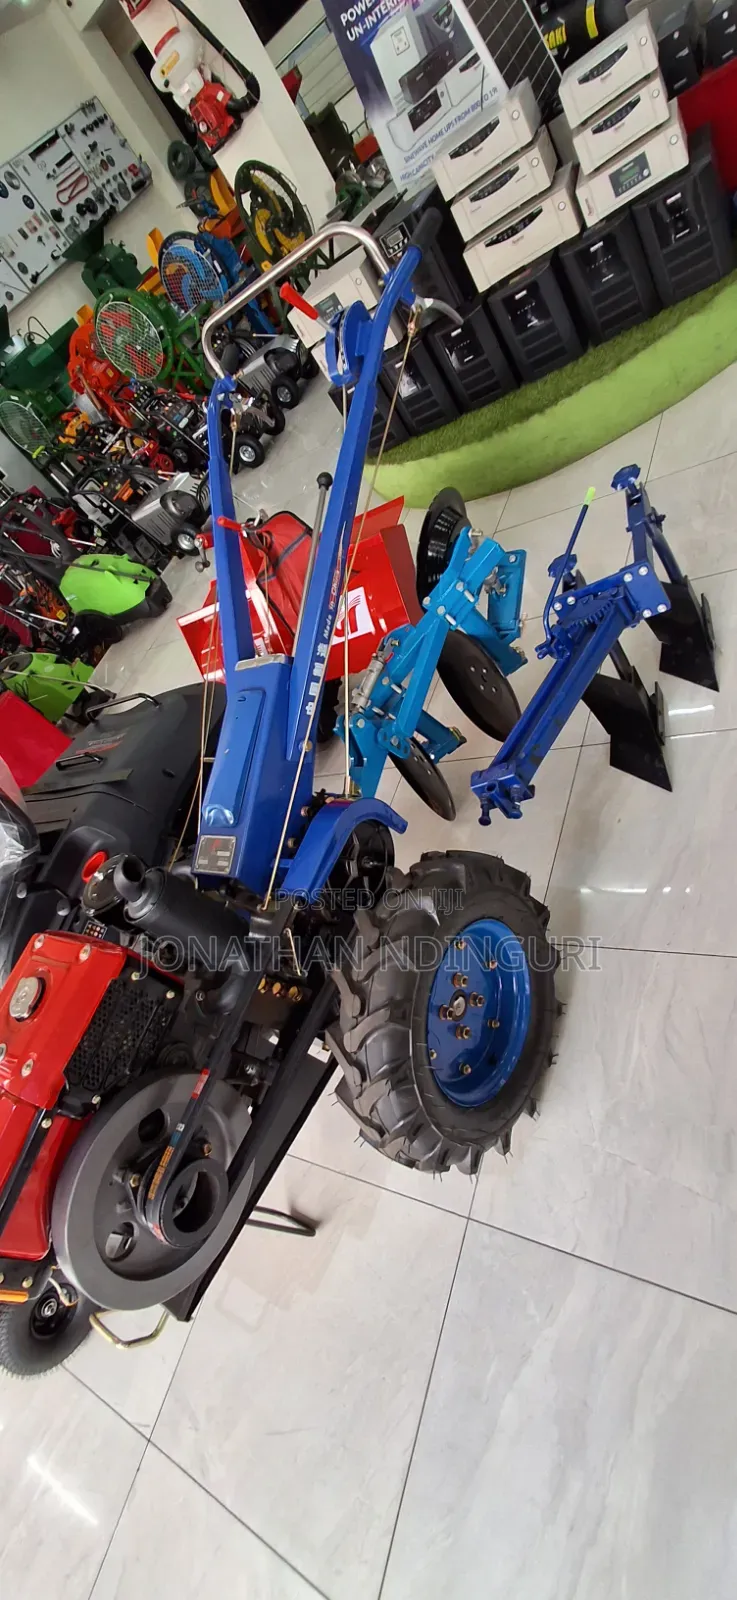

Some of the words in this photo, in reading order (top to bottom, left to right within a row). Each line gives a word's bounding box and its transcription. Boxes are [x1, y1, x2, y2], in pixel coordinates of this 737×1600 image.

[340, 0, 376, 26] POWE
[428, 130, 444, 144] HOME
[444, 122, 455, 133] UPS
[454, 110, 471, 124] FROM
[322, 613, 332, 640] Made
